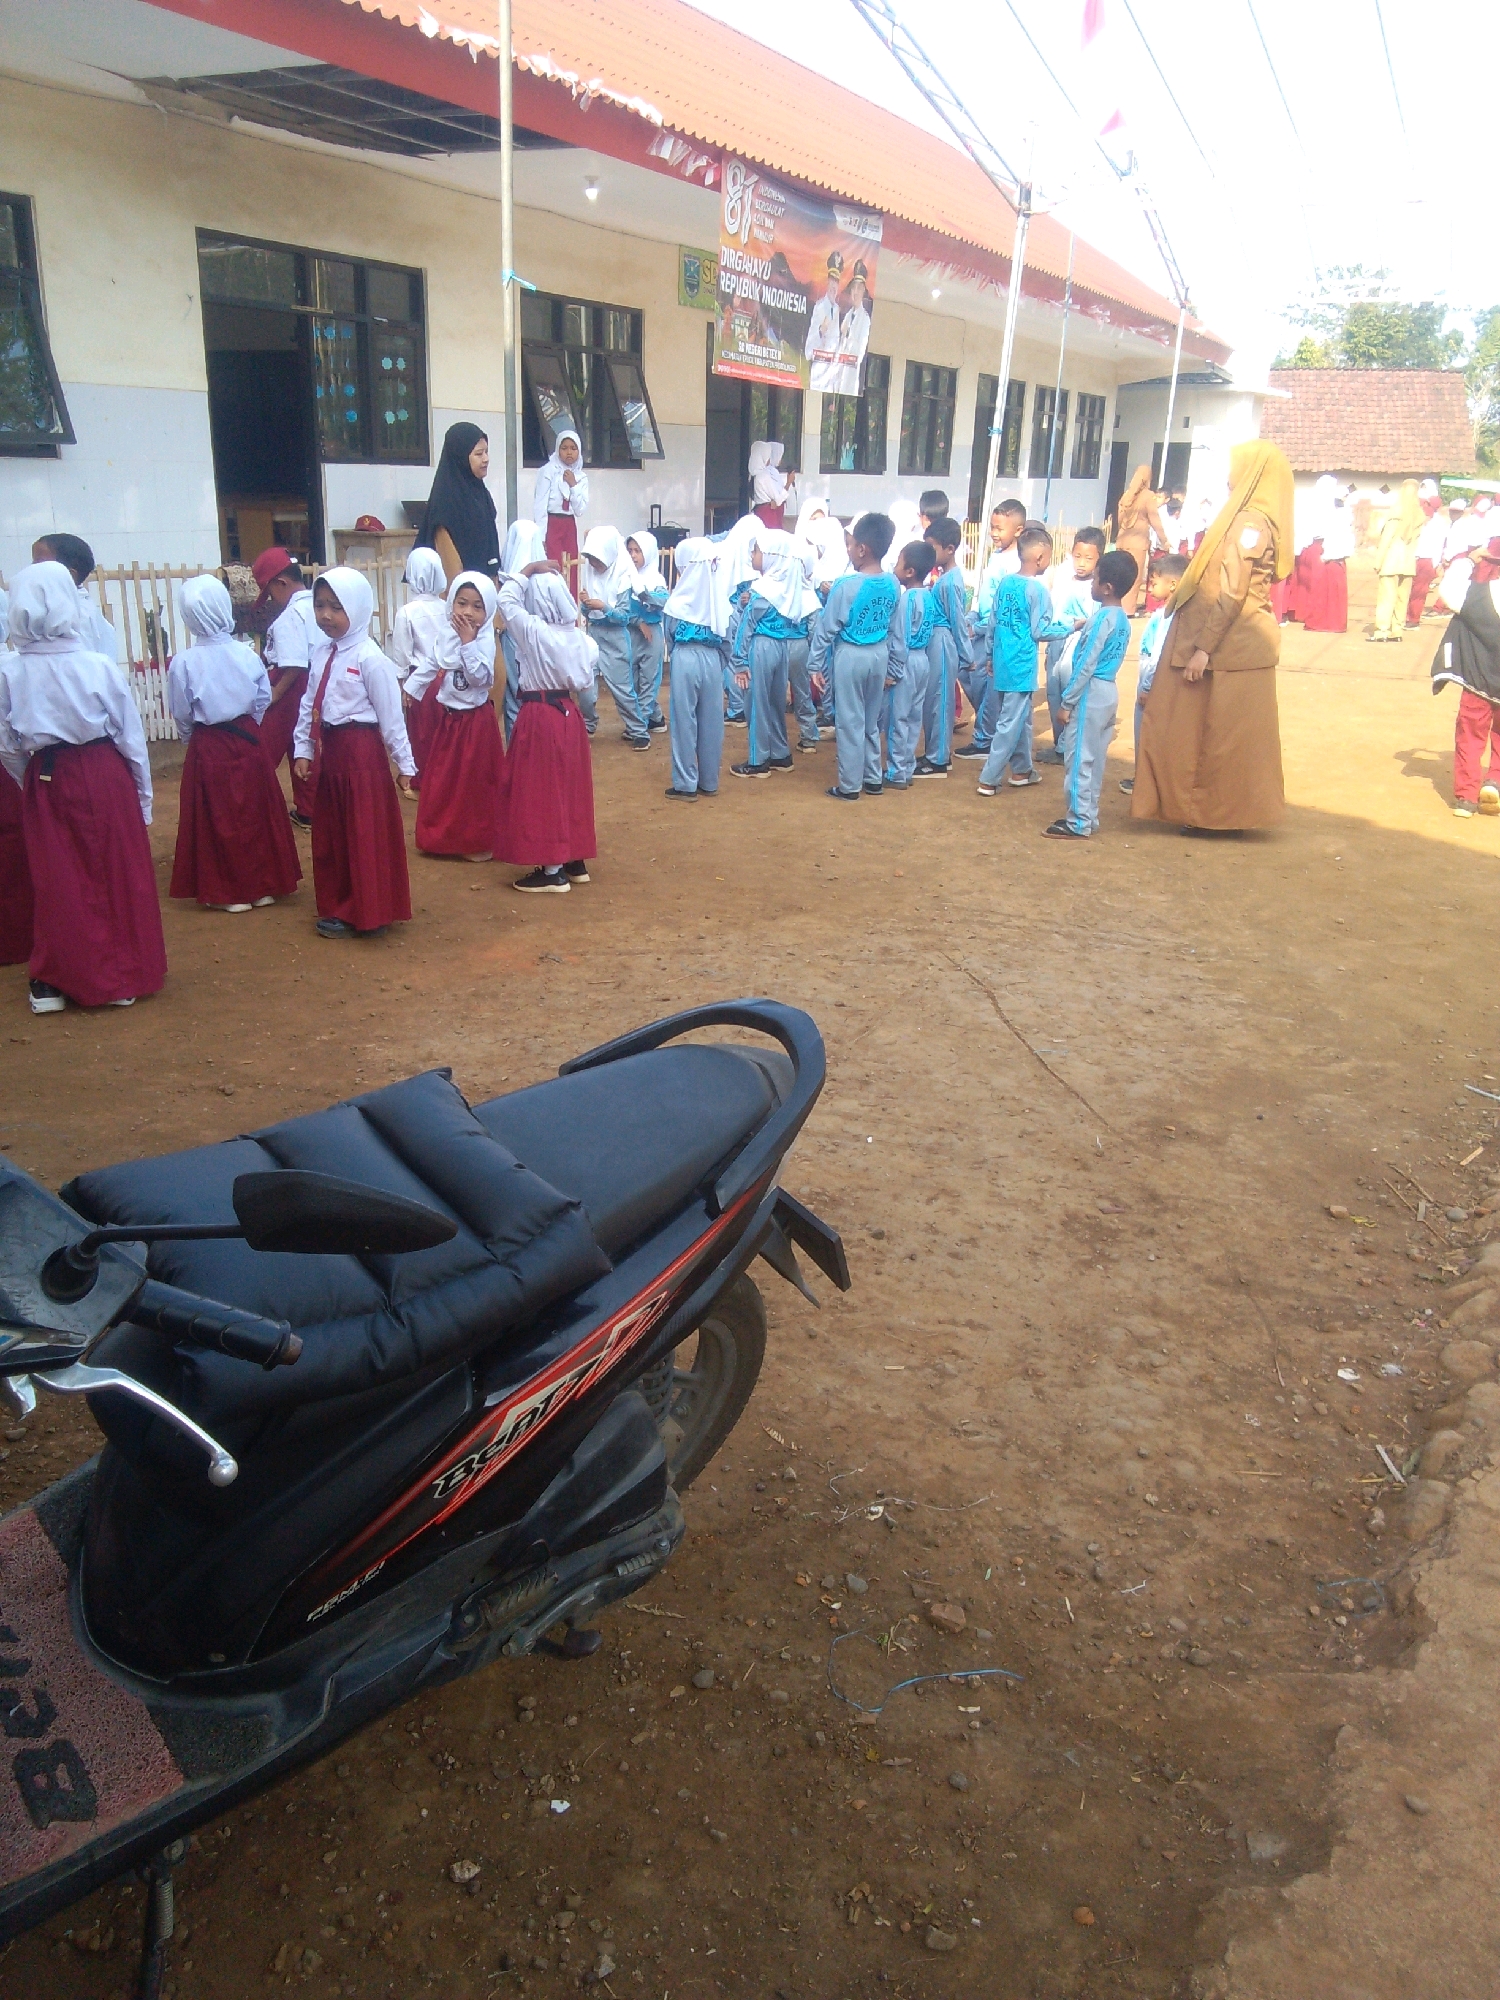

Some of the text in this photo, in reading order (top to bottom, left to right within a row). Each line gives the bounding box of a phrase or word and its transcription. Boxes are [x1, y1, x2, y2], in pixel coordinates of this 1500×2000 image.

[720, 245, 772, 281] DIRGAHAYU
[719, 271, 807, 315] REPUBLIK INDONESIA
[873, 610, 884, 621] 21
[695, 625, 707, 636] 21
